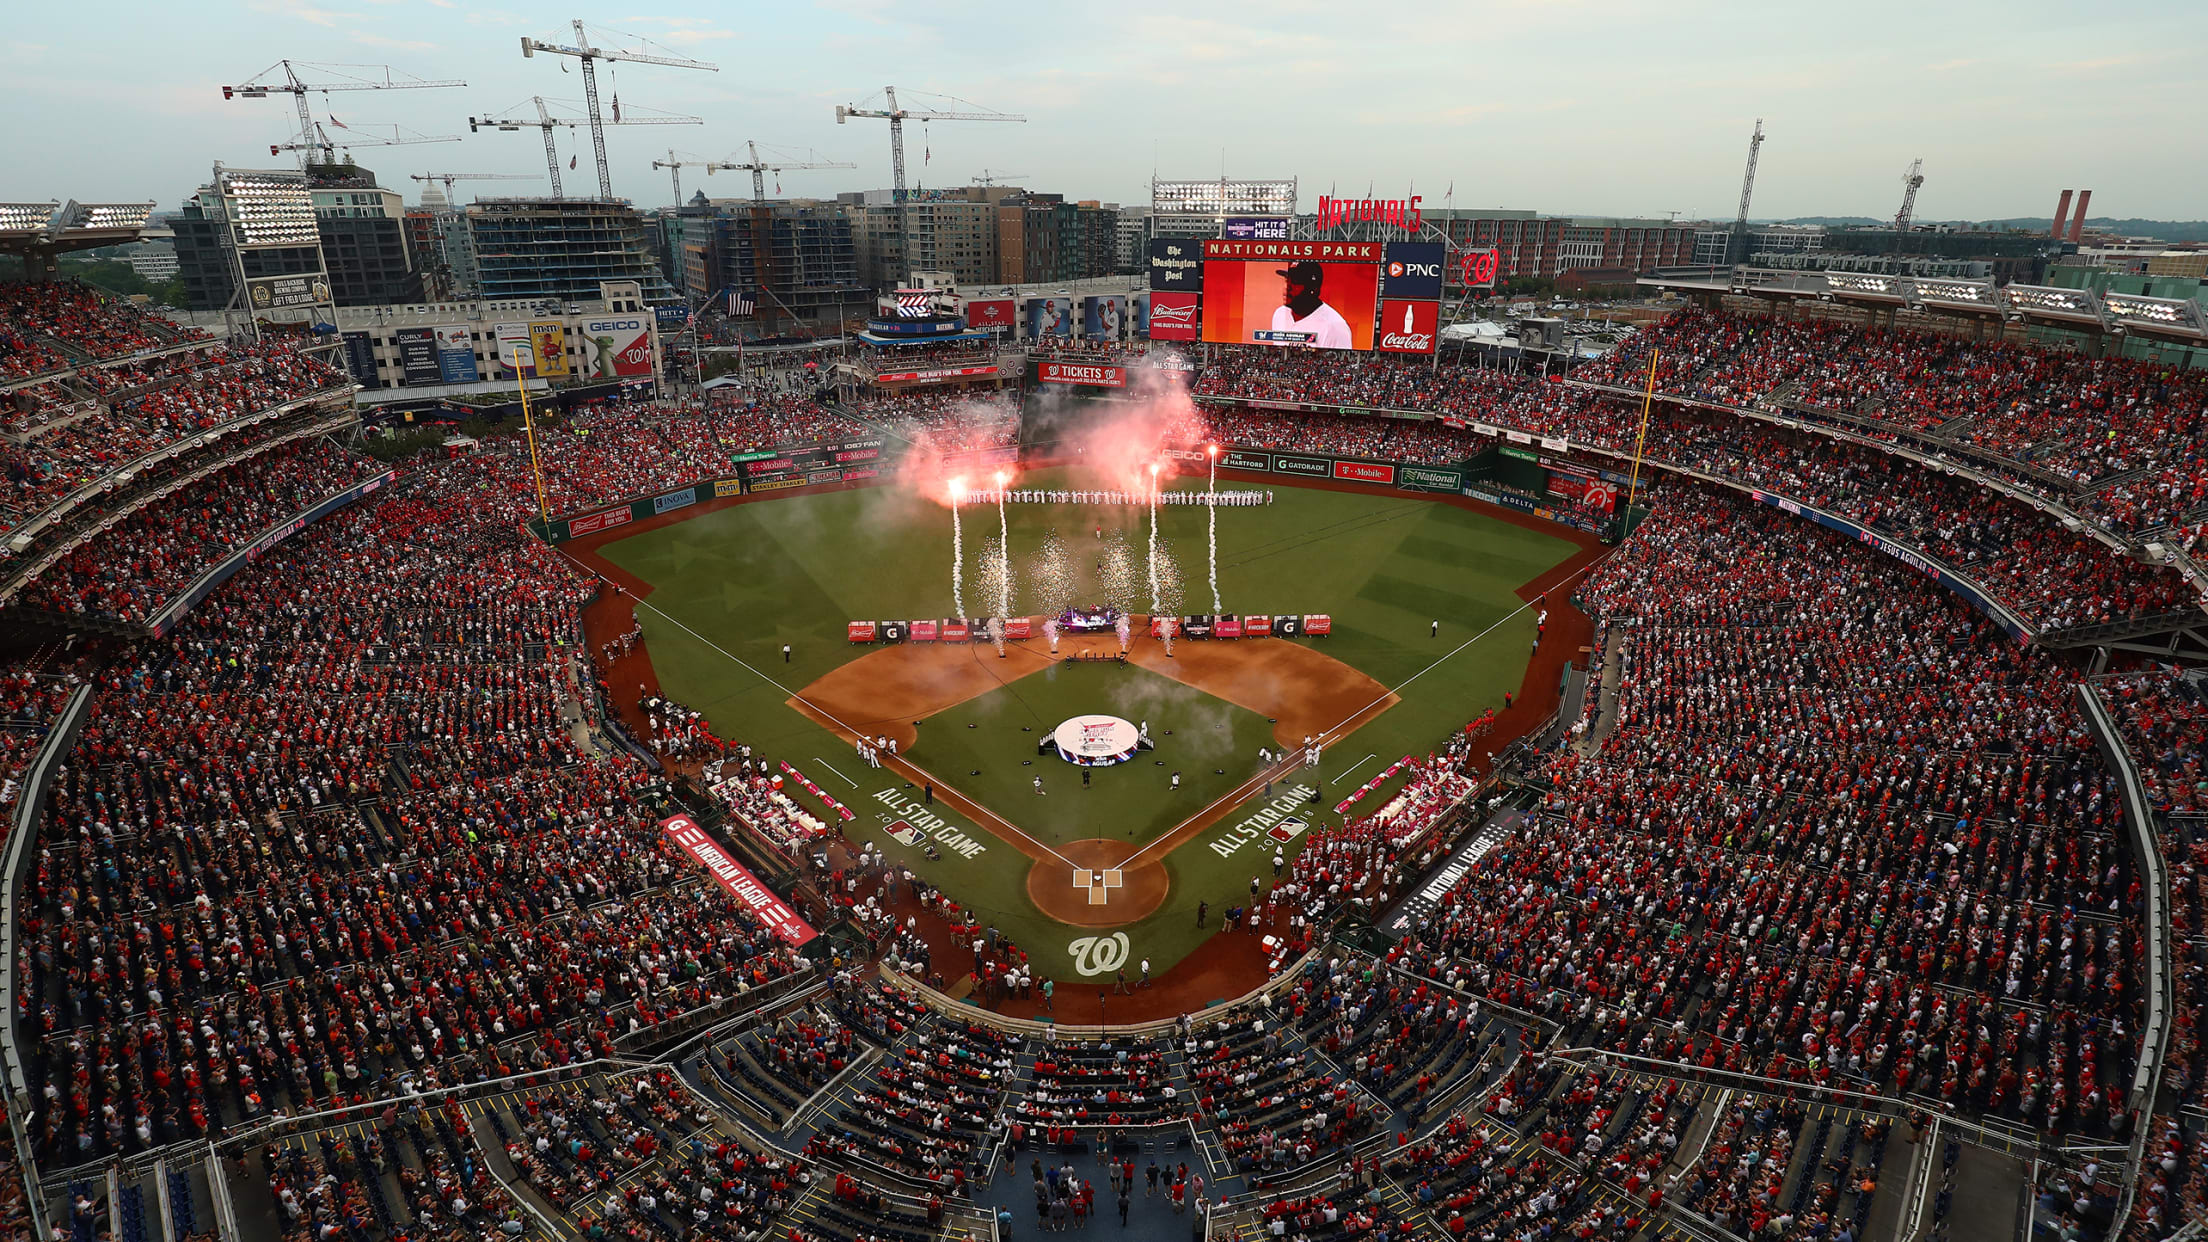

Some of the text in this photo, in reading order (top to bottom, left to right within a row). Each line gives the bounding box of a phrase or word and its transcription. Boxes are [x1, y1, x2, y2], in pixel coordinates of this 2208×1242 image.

[1317, 195, 1422, 233] NATIONALS
[1254, 221, 1278, 229] HIT IT
[1254, 229, 1287, 238] HERE
[1166, 245, 1182, 256] The
[1210, 243, 1371, 258] NATIONALS PARK
[1152, 256, 1197, 270] Washington
[1406, 262, 1440, 277] PNC
[1165, 270, 1183, 282] Post
[272, 293, 314, 306] LEFT FIELD LODGE
[1155, 305, 1193, 317] Budweiser
[589, 320, 640, 332] GEICO
[399, 333, 423, 341] CURLY
[1382, 332, 1433, 350] Coca-Cola
[1061, 365, 1102, 379] TICKETS
[1152, 361, 1194, 371] ALL STAR GAME
[1162, 449, 1204, 461] GEICO
[1229, 459, 1264, 468] HARTFORD
[1288, 462, 1325, 472] GATORADE
[1416, 471, 1457, 483] National
[664, 492, 690, 505] INOVA
[1509, 497, 1534, 509] DELTA
[605, 518, 615, 526] FOR
[1880, 541, 1900, 558] JESUS
[1900, 551, 1927, 572] AGUILAR
[886, 627, 897, 639] G
[1284, 622, 1295, 632] G
[872, 787, 987, 860] ALL STAR GAME
[1208, 784, 1318, 858] ALL STAR GAME
[1420, 836, 1495, 902] NATIONAL LEAGUE
[692, 842, 773, 910] AMERICAN LEAGUE
[1068, 931, 1130, 977] W
